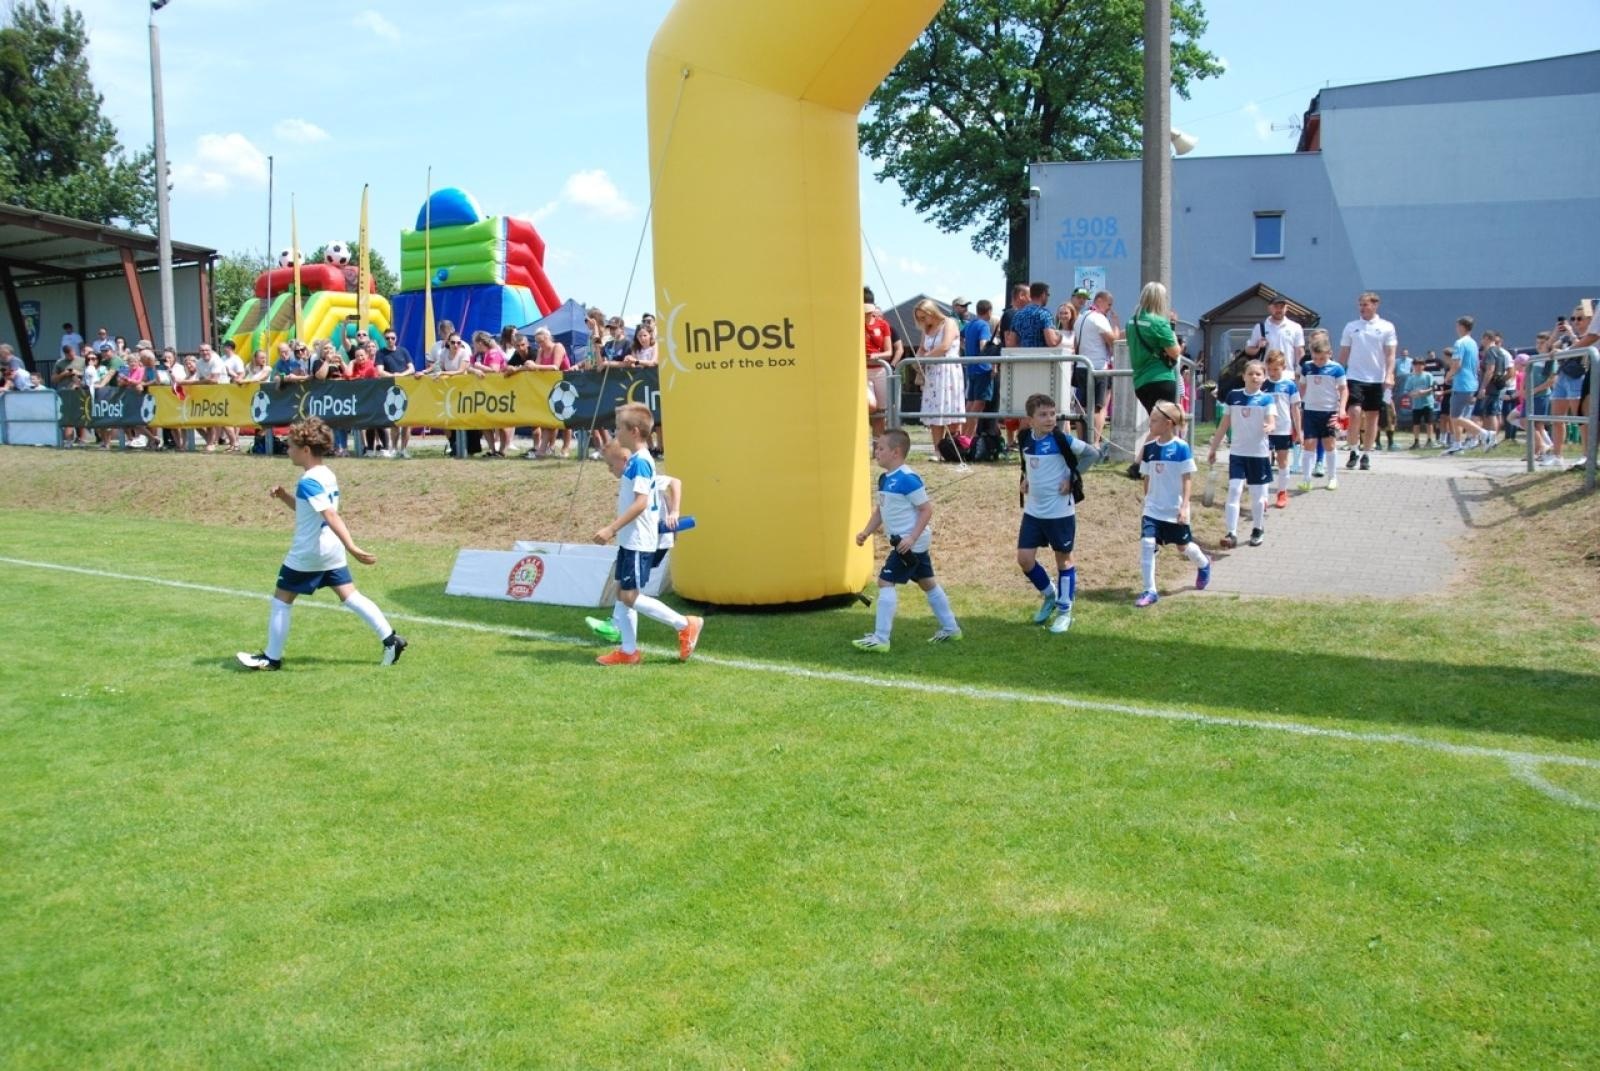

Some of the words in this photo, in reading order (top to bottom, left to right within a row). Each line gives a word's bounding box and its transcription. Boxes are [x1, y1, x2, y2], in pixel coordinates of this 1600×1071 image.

[1061, 216, 1118, 238] 1908
[685, 317, 796, 353] InPost
[695, 359, 717, 370] out
[720, 358, 735, 369] of
[739, 357, 764, 368] the
[768, 356, 796, 367] box
[91, 399, 124, 417] InPost
[190, 399, 229, 417] InPost
[309, 394, 357, 416] InPost
[457, 390, 516, 414] InPost
